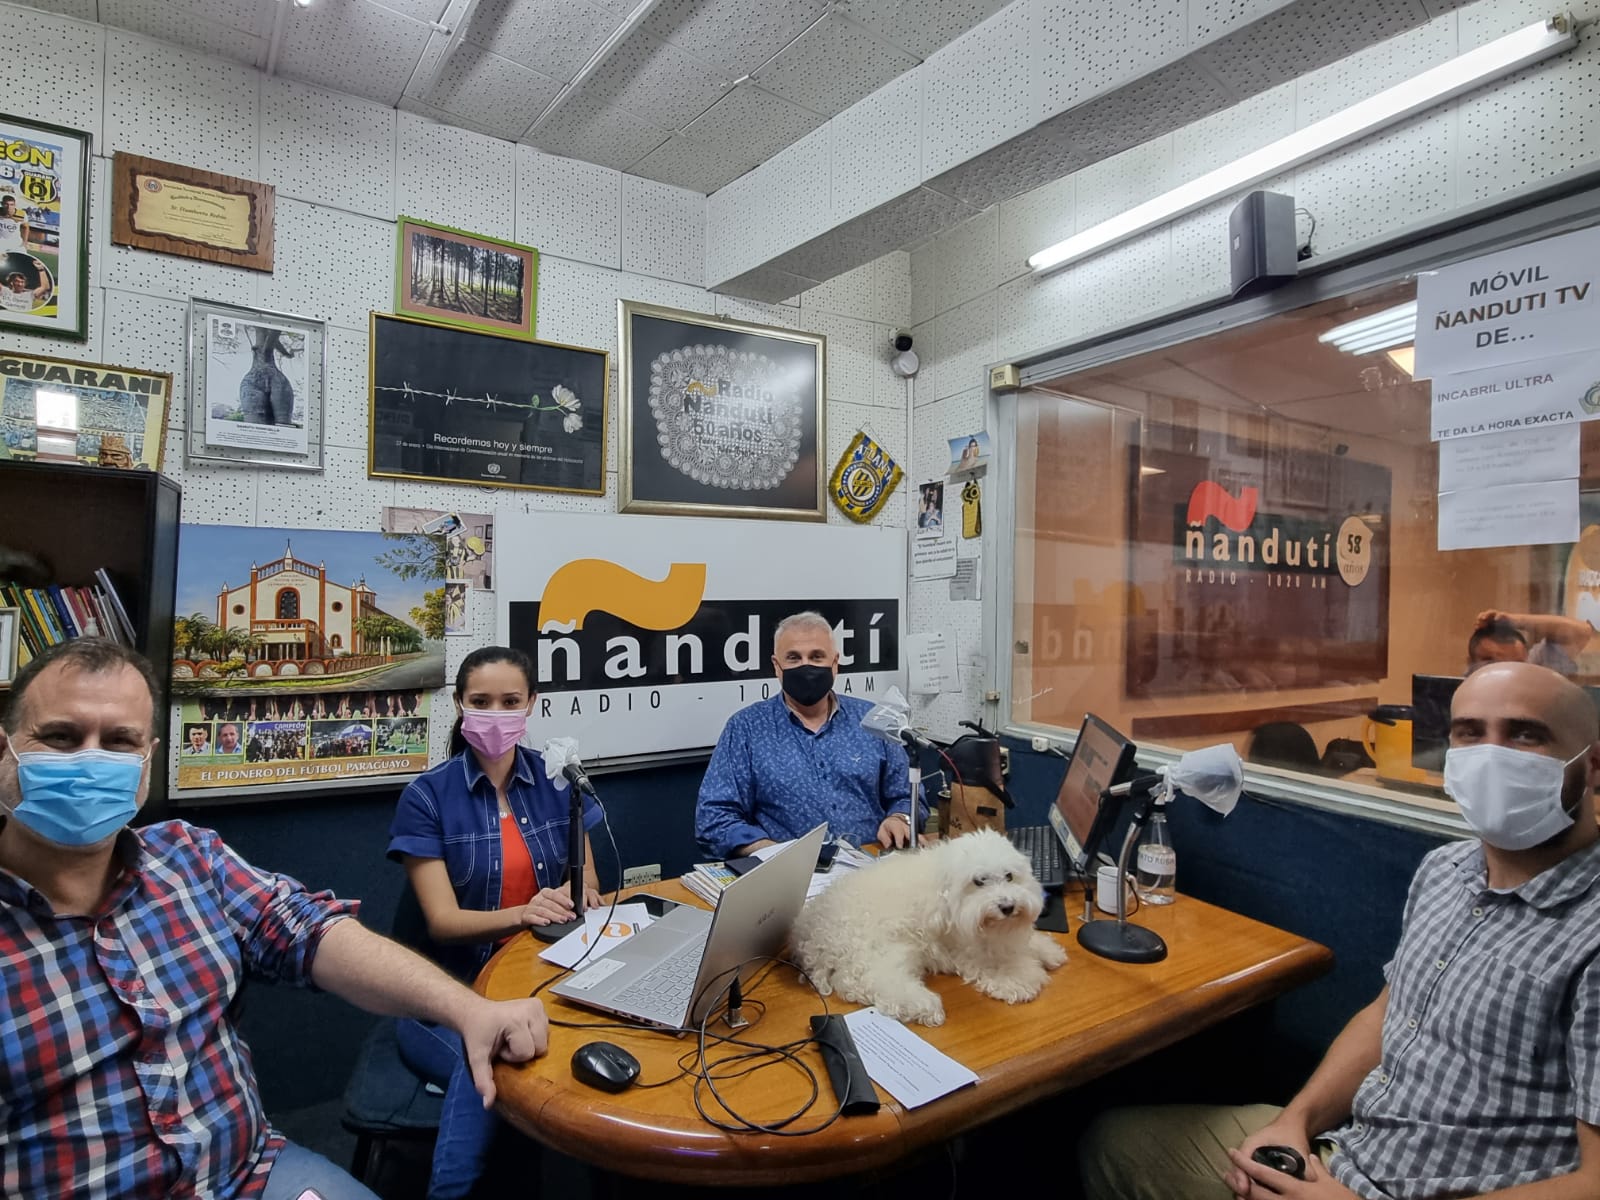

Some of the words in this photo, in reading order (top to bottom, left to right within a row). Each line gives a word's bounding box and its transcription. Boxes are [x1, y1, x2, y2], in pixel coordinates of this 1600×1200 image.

[1469, 265, 1549, 297] MÓVIL
[1435, 292, 1547, 330] ÑANDUTI
[1554, 282, 1591, 305] TV
[1475, 327, 1535, 348] DE...
[0, 359, 162, 395] GUARANI
[1437, 383, 1501, 403] INCABRIL
[1505, 373, 1554, 391] ULTRA
[1437, 428, 1450, 439] TE
[1453, 426, 1468, 437] DA
[1471, 423, 1485, 433] LA
[1488, 418, 1521, 430] HORA
[1524, 410, 1574, 425] EXACTA
[433, 433, 491, 448] Recordemos
[493, 439, 510, 451] hoy
[511, 443, 518, 452] y
[519, 443, 553, 454] siempre
[1186, 520, 1332, 568] ñandutí
[1347, 534, 1362, 555] 58
[1186, 569, 1236, 585] RADIO
[1311, 576, 1327, 589] AM
[537, 613, 885, 683] ñandtí
[541, 690, 661, 718] RADIO
[844, 676, 875, 694] AM
[274, 722, 306, 730] CAMPEÓN
[201, 771, 214, 781] EL
[217, 768, 273, 781] PIONERO
[276, 766, 296, 777] DEL
[300, 763, 342, 775] FÚTBOL
[346, 758, 410, 772] PARAGUAYO
